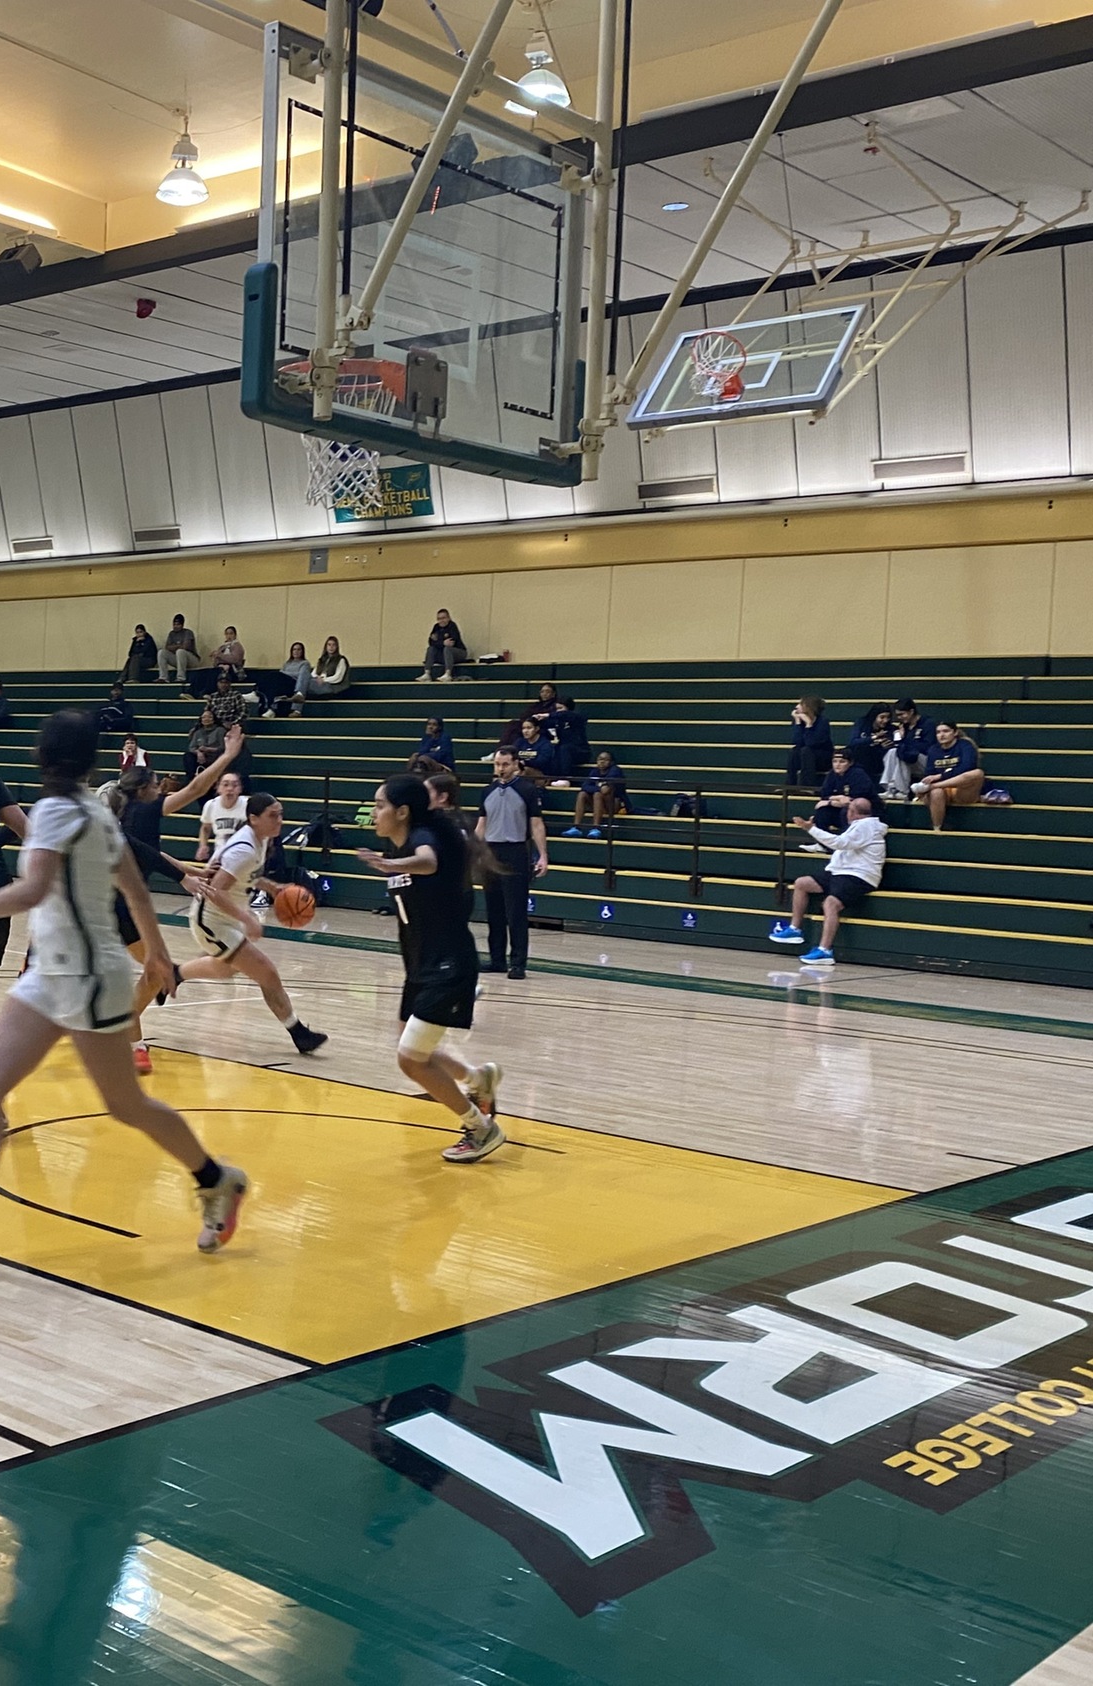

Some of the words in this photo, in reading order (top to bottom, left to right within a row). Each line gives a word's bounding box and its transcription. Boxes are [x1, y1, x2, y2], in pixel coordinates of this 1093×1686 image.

[354, 502, 413, 519] CHAMPIONS
[394, 894, 409, 925] 1
[882, 1379, 1093, 1487] COLLEGE
